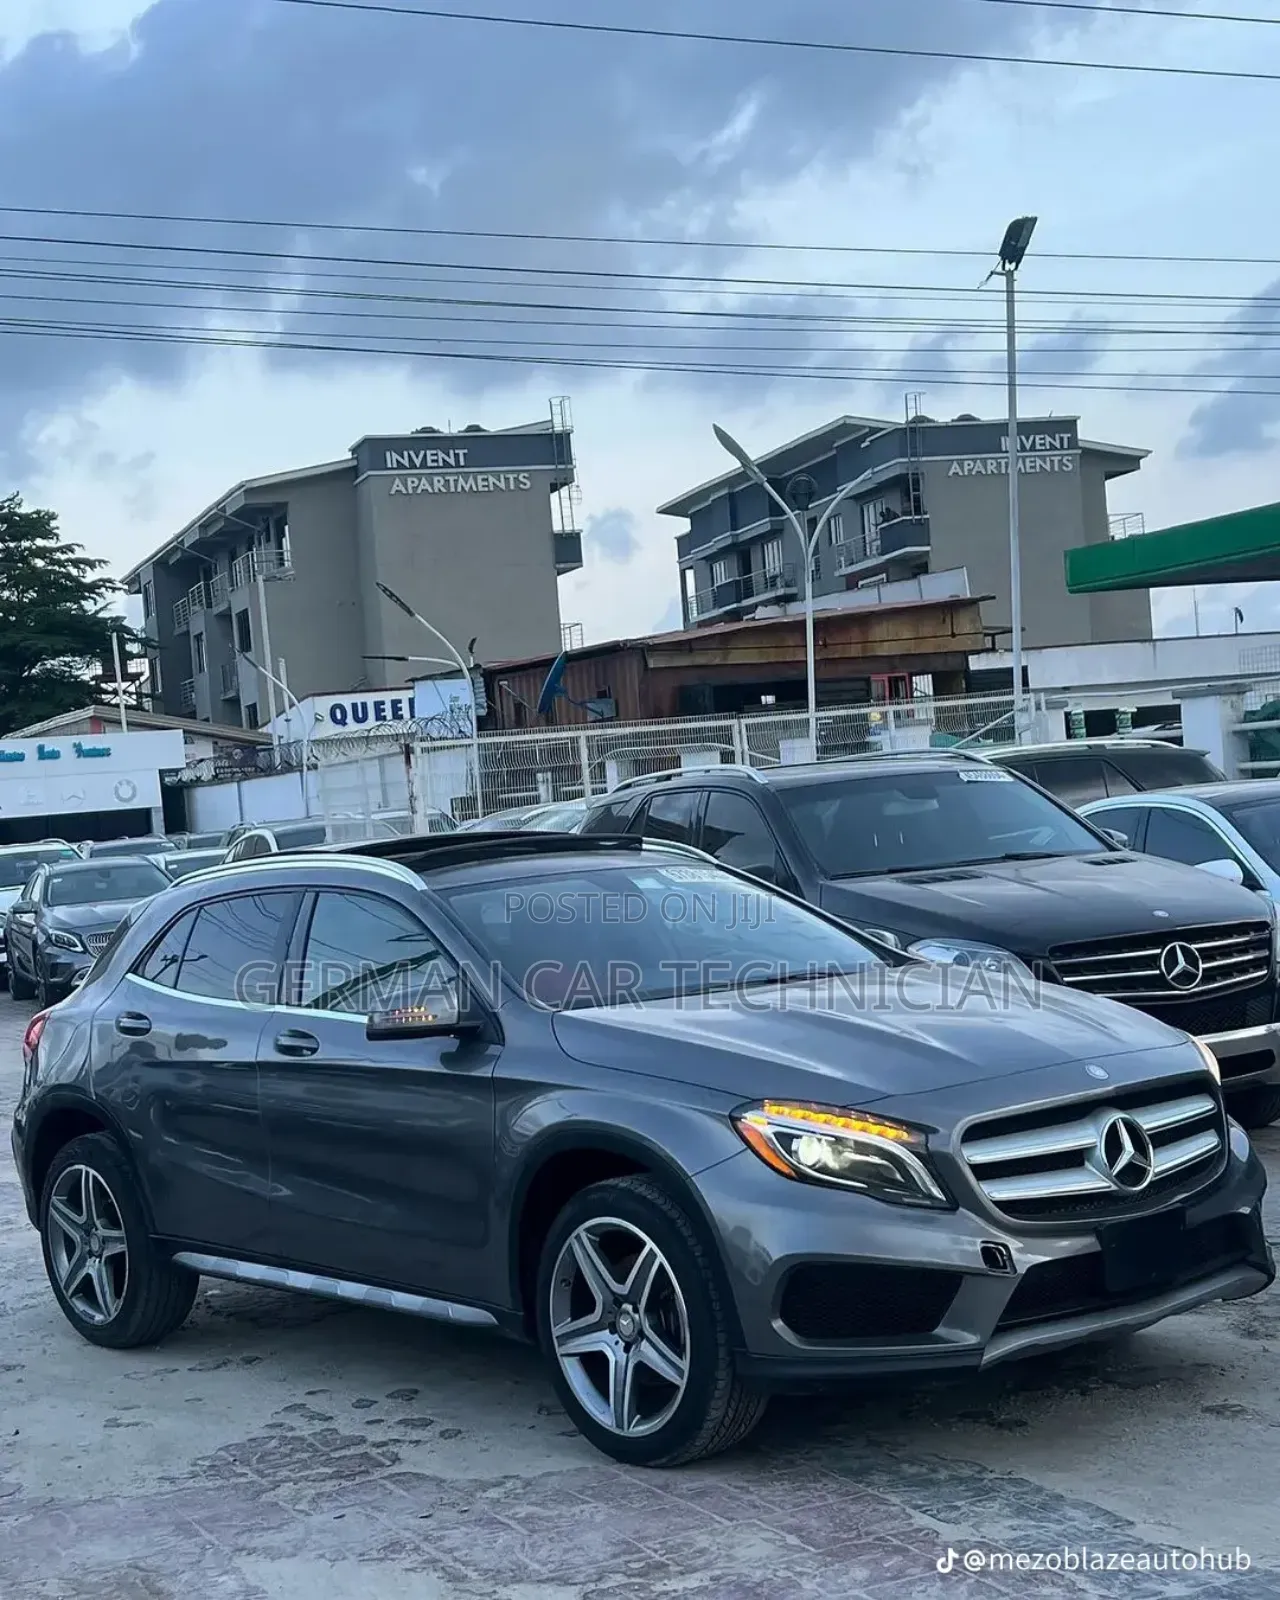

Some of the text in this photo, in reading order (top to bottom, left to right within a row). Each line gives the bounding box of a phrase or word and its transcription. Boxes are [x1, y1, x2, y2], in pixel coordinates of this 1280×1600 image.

[385, 448, 468, 469] INVENT
[948, 456, 1074, 477] APARTMENTS
[389, 472, 532, 496] APARTMENTS
